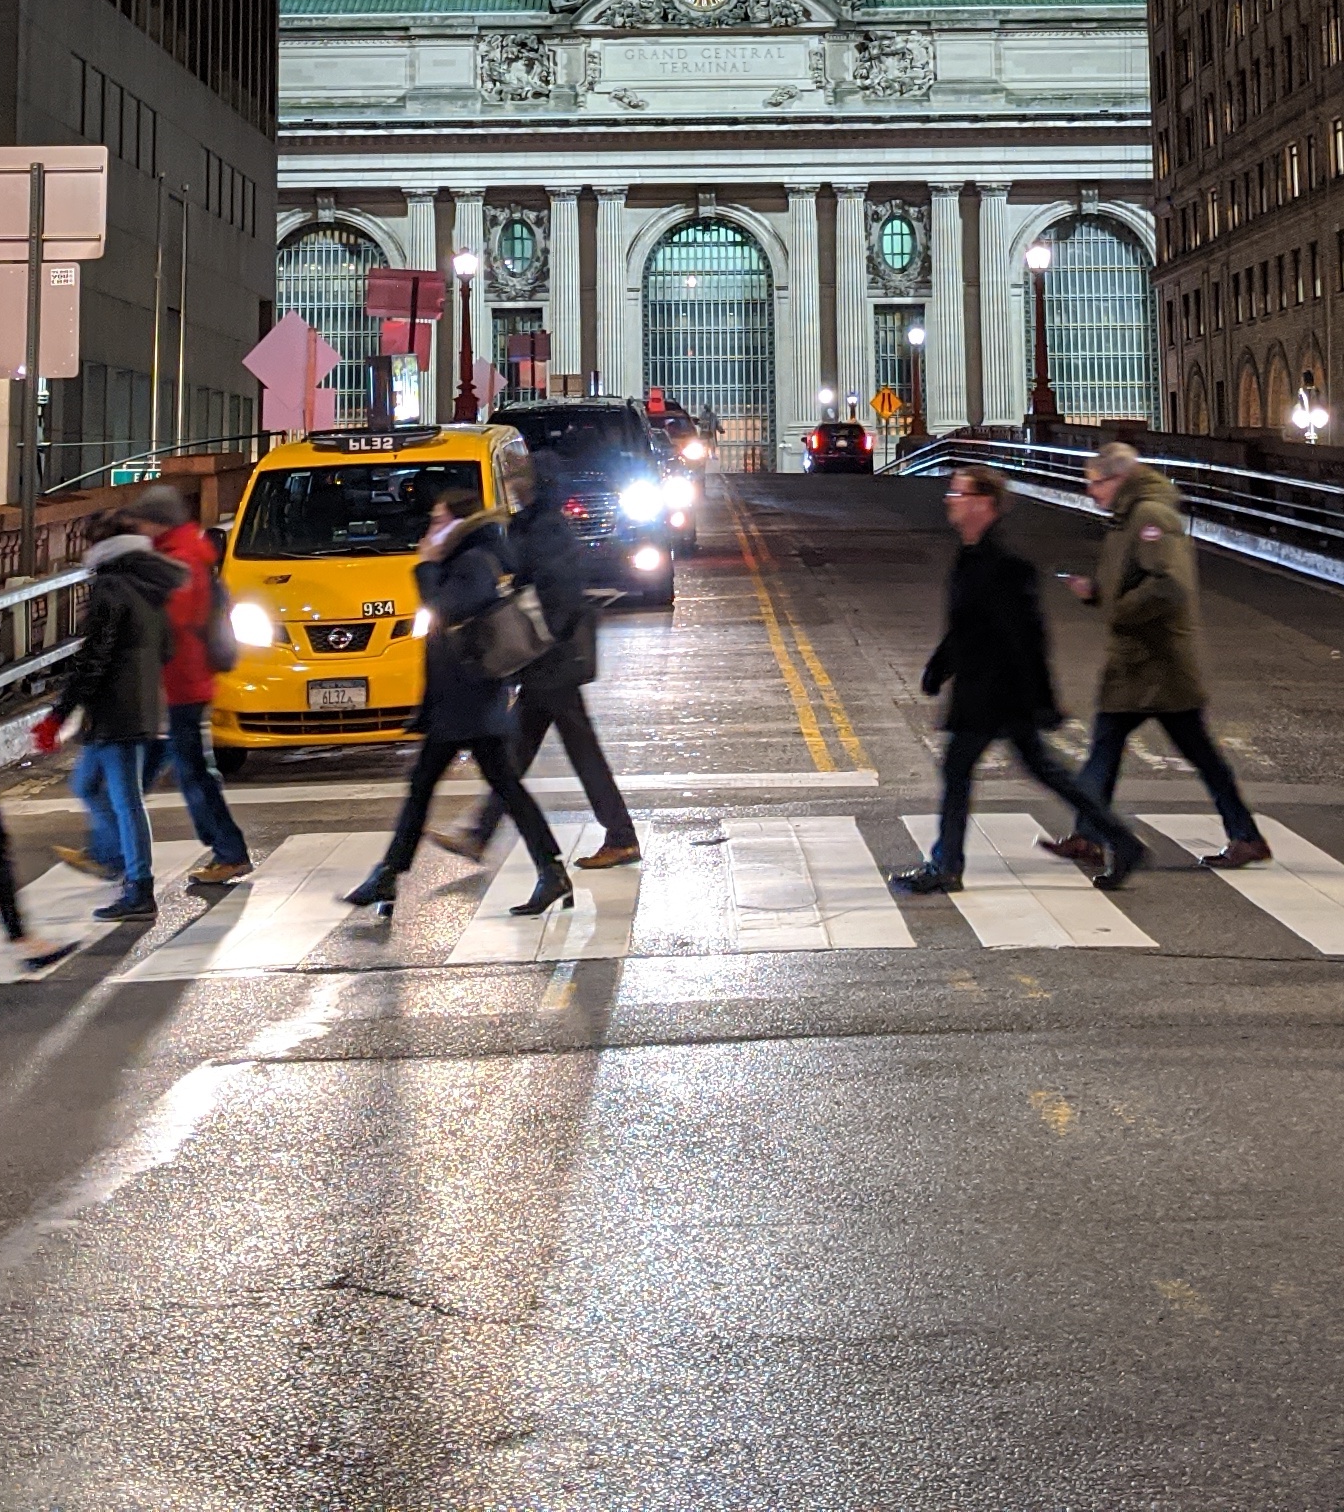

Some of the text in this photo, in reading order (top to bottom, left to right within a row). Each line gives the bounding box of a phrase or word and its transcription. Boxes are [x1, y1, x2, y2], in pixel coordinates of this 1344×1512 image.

[624, 47, 785, 61] GRAND CENTRAL
[659, 61, 751, 74] TERMINAL
[348, 436, 394, 451] 6L32
[363, 601, 394, 617] 934
